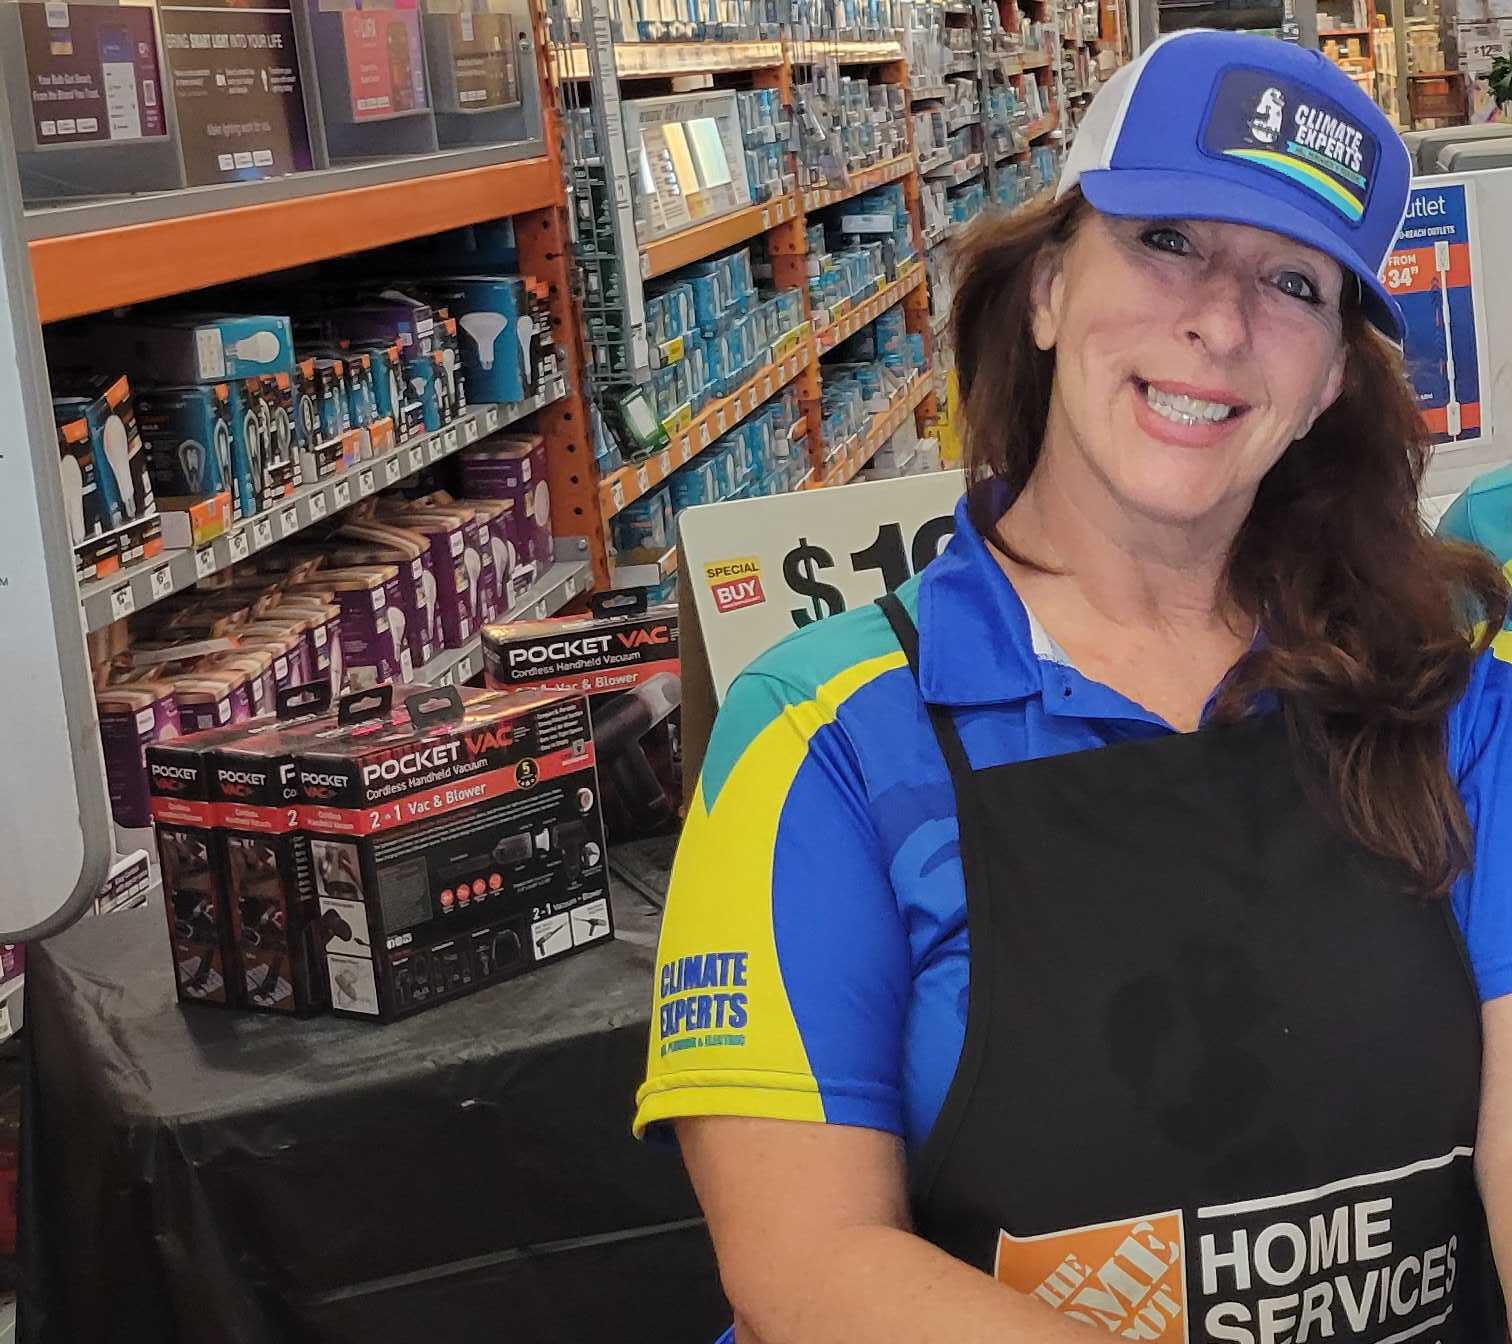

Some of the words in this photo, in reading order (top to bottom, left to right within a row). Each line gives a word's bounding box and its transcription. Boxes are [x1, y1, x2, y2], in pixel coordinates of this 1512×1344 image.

[1295, 104, 1363, 149] CLIMATE
[1296, 127, 1363, 173] EXPERTS
[1404, 195, 1447, 219] utlet
[1388, 253, 1416, 268] FROM
[706, 562, 760, 578] SPECIAL
[715, 578, 758, 606] BUY
[509, 635, 613, 667] POCKET
[617, 626, 668, 649] VAC
[512, 664, 555, 679] Cordless
[556, 657, 601, 672] Handheld
[603, 651, 641, 664] Vacuum
[582, 678, 592, 689] &
[595, 673, 639, 687] Blower
[363, 741, 462, 786] POCKET
[465, 724, 513, 754] VAC
[151, 764, 197, 781] POCKET
[217, 769, 266, 786] POCKET
[301, 772, 349, 787] POCKET
[366, 781, 407, 801] Cordless
[408, 766, 451, 789] Handheld
[452, 757, 488, 776] Vacuum
[408, 798, 431, 814] Vac
[433, 794, 442, 807] &
[446, 784, 486, 804] Blower
[660, 952, 748, 998] CLIMATE
[660, 993, 748, 1041] EXPERTS
[1201, 1197, 1393, 1295] HOME
